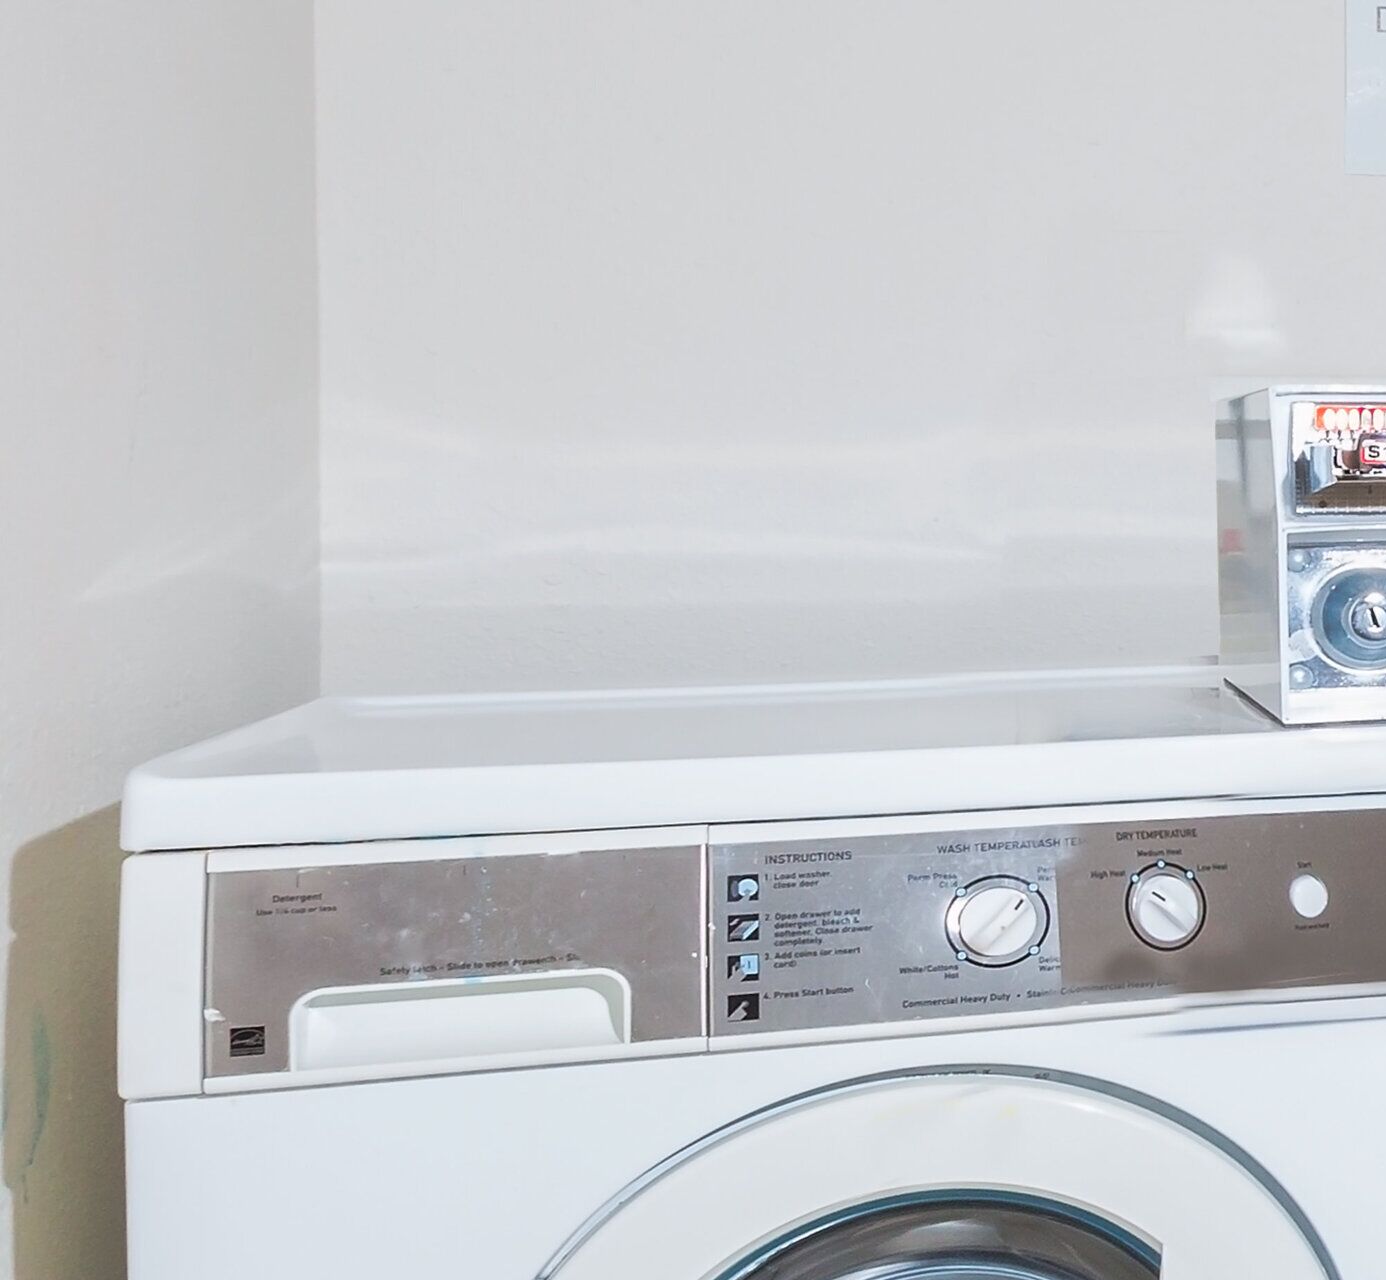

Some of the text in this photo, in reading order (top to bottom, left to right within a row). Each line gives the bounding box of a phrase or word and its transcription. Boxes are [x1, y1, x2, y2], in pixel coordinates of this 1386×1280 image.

[1115, 828, 1198, 841] DRY TEMPERATURE
[937, 843, 970, 854] WASH
[764, 850, 852, 864] INSTRUCTIONS
[775, 912, 798, 921] Open
[800, 910, 832, 919] drawer
[842, 925, 873, 933] drawer
[775, 951, 792, 959] Add
[794, 950, 817, 958] coins
[802, 988, 823, 997] Start
[826, 987, 854, 995] button
[902, 993, 1011, 1008] Commercial Heavy Duty
